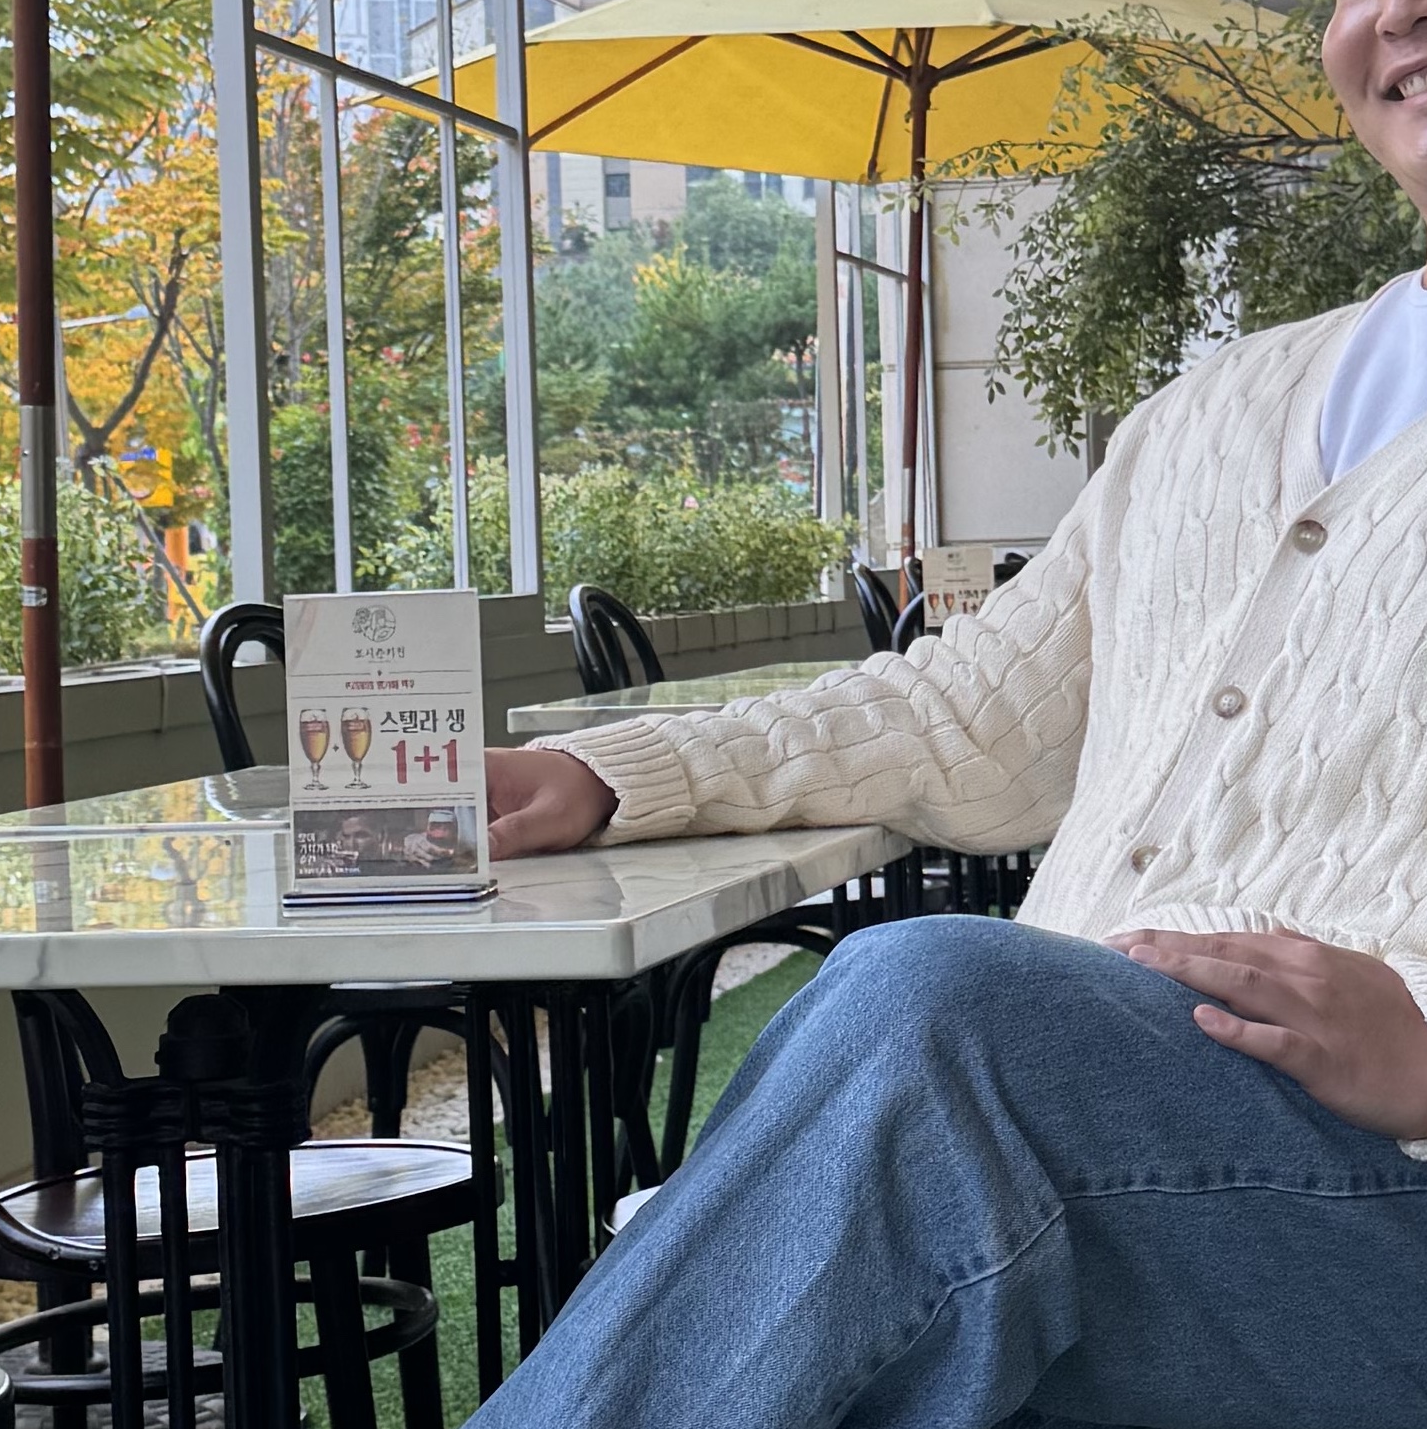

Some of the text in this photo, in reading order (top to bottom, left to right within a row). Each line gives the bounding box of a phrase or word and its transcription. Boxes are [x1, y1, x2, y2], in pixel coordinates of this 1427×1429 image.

[380, 708, 465, 733] 스텔라 생
[391, 738, 458, 785] 1+1
